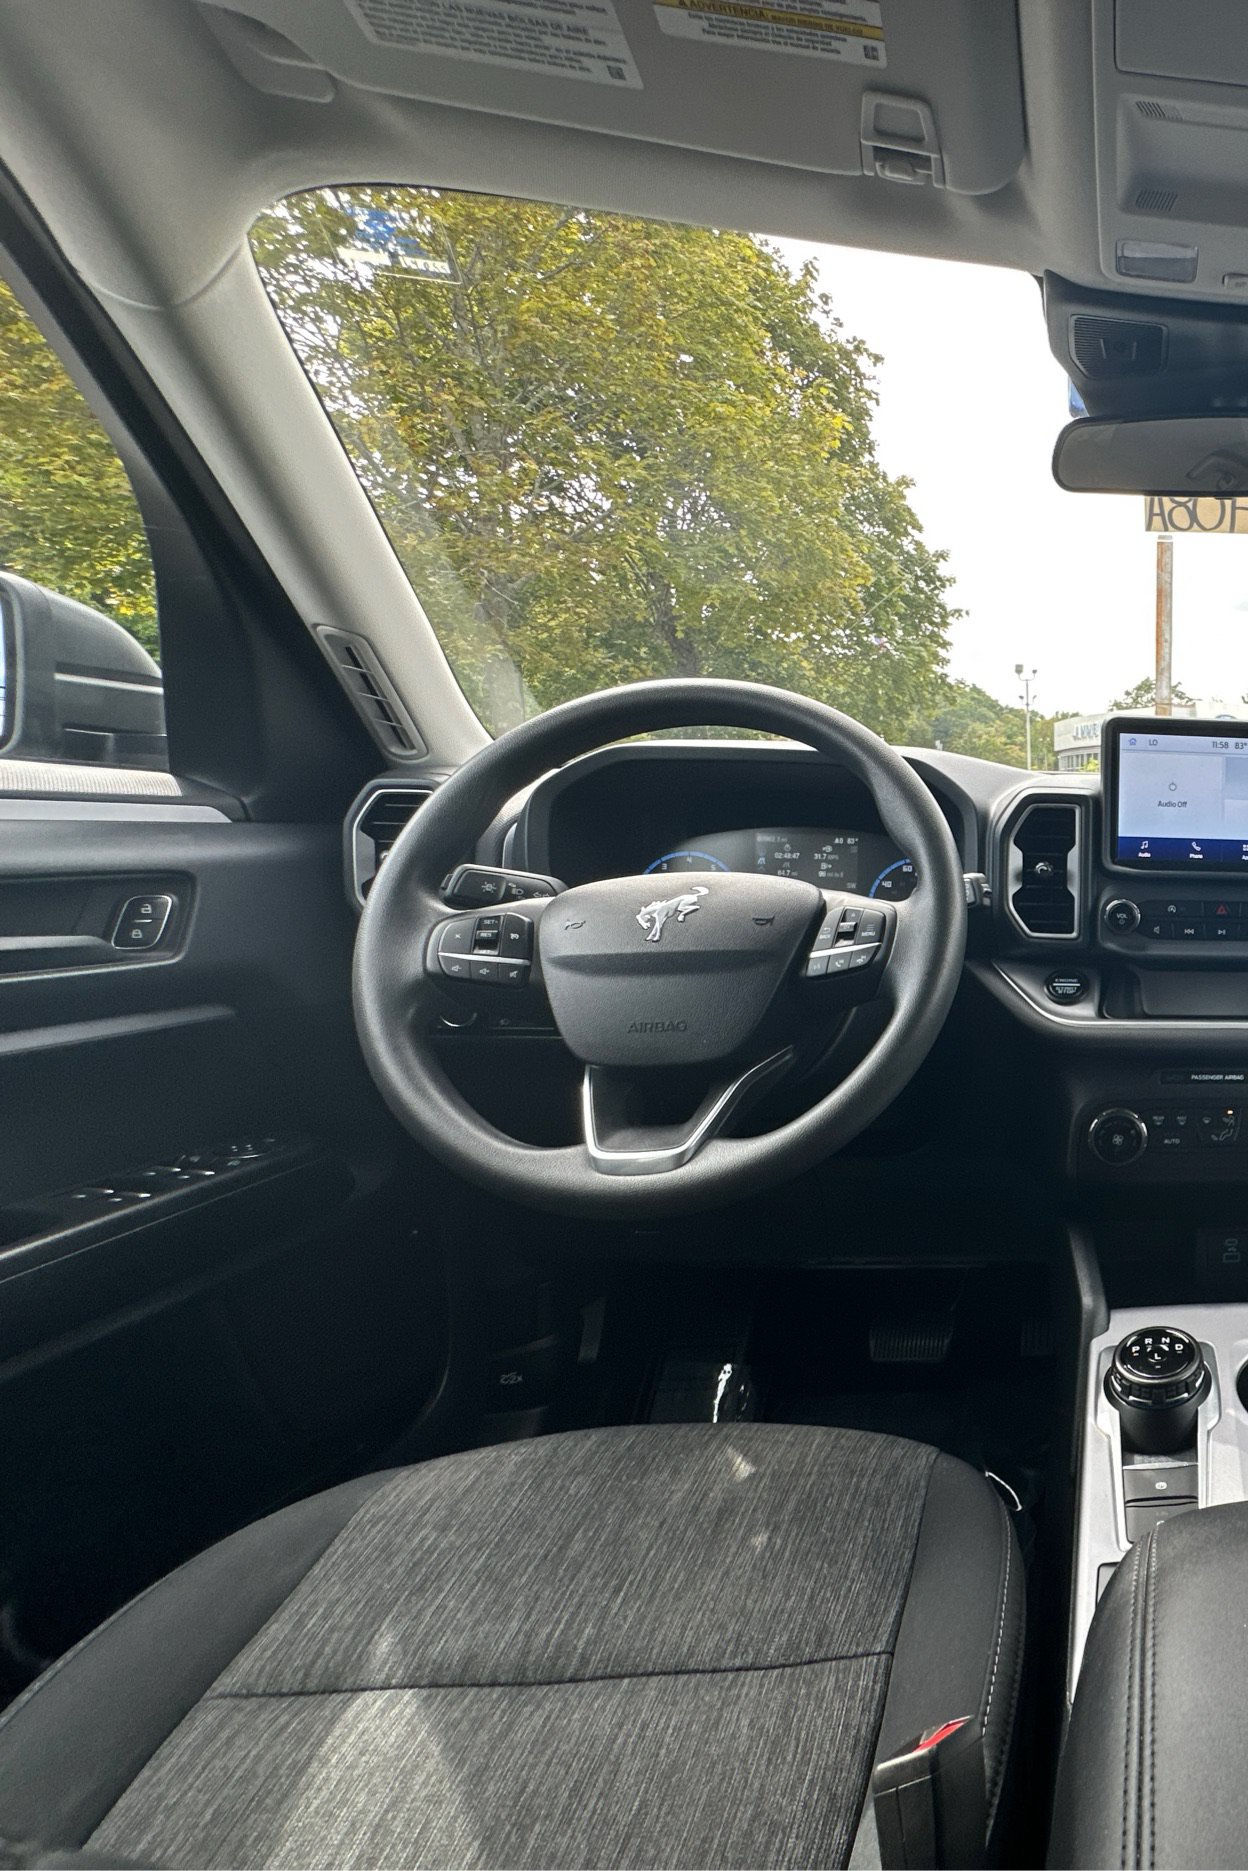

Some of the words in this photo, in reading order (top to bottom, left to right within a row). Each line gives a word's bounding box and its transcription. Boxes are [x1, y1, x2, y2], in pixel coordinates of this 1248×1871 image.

[1211, 741, 1230, 750] 11:58
[1157, 801, 1177, 809] Audio
[1177, 801, 1188, 809] Off
[882, 880, 893, 888] 40
[626, 1020, 688, 1033] AIRBAG
[1190, 1074, 1224, 1082] PASSENGER
[1224, 1074, 1245, 1082] AIRBAG
[1144, 1337, 1153, 1345] R
[1131, 1345, 1140, 1354] P
[1174, 1343, 1184, 1351] D
[1154, 1352, 1162, 1360] L
